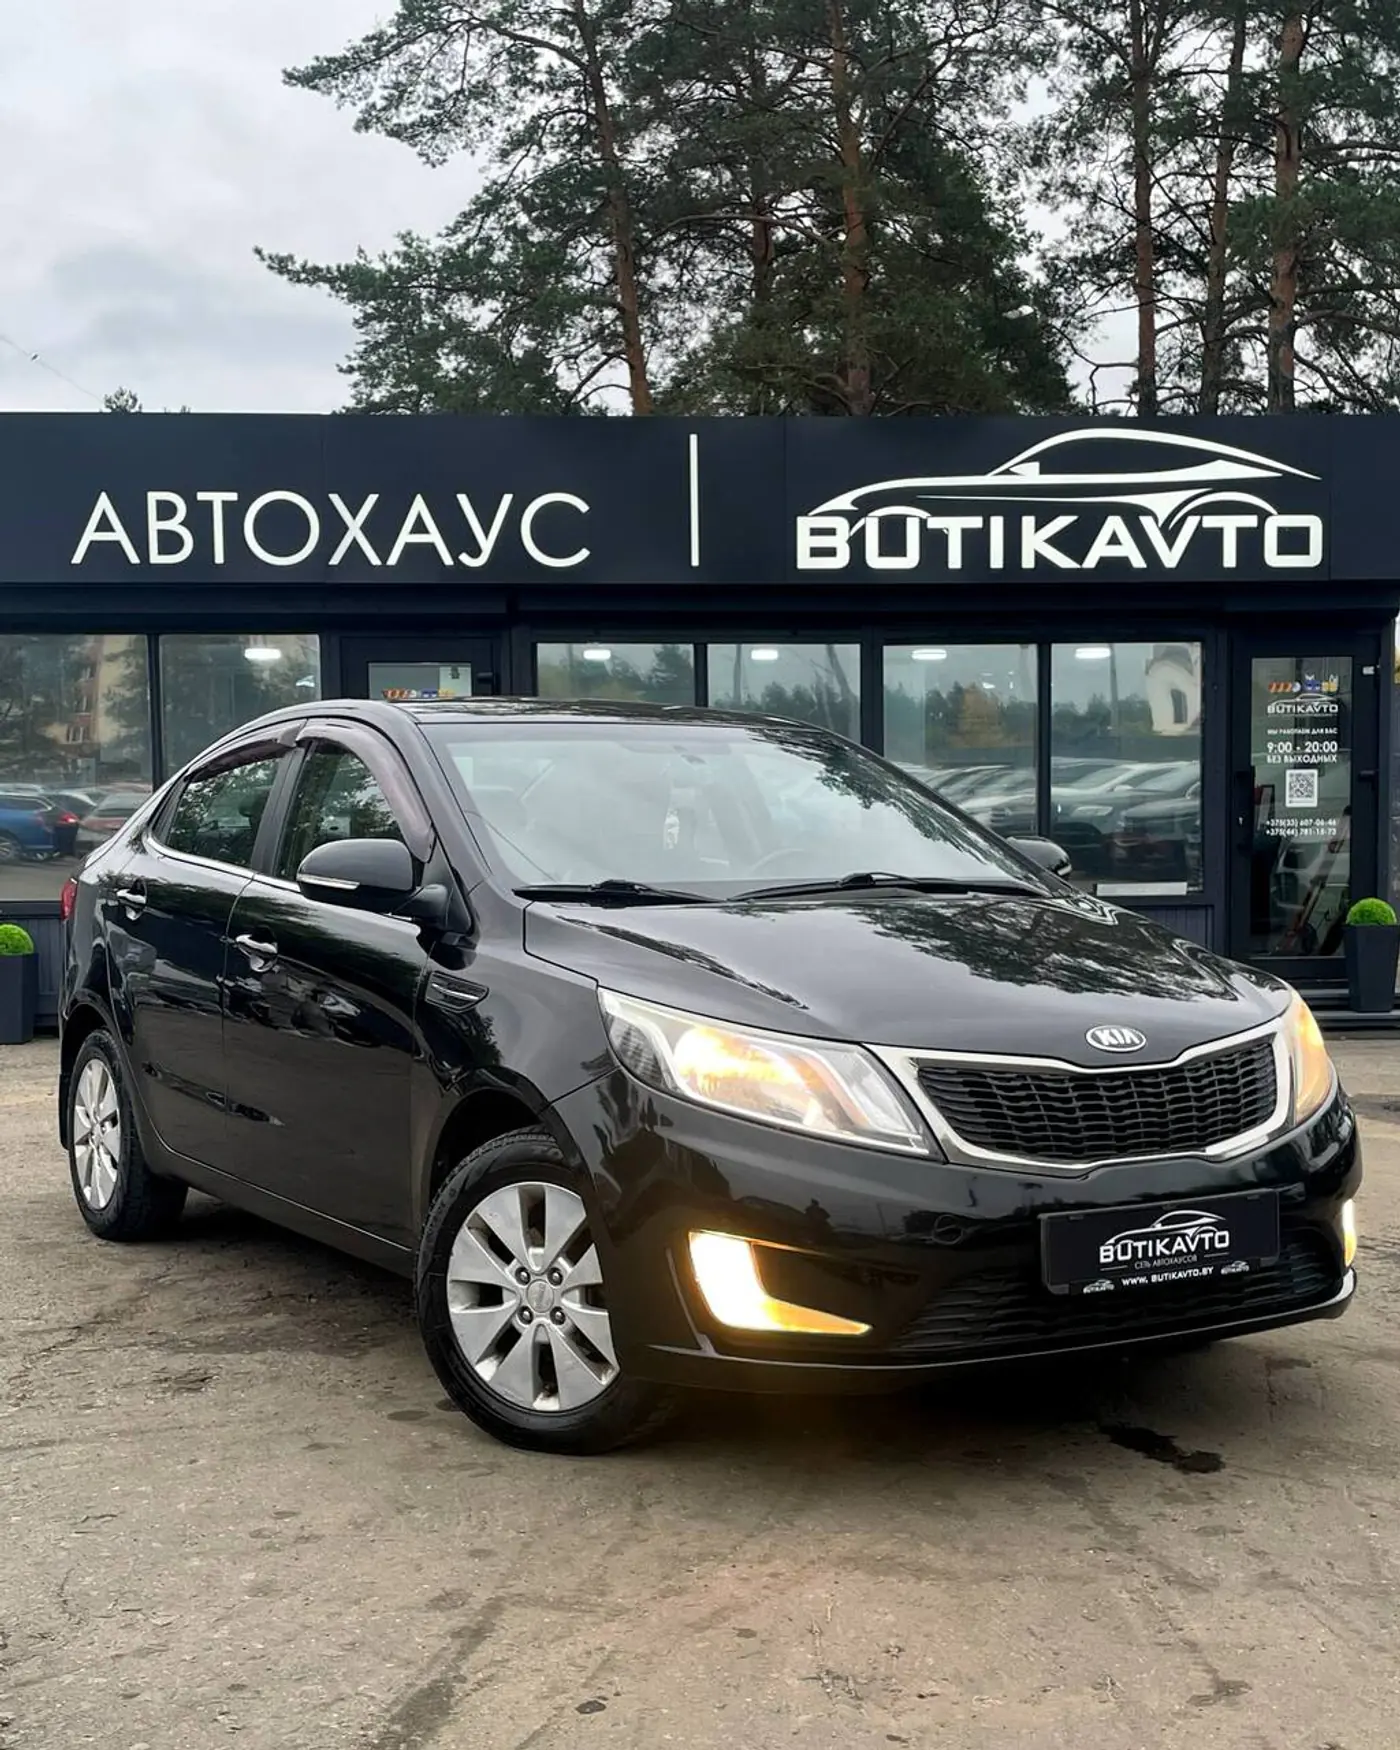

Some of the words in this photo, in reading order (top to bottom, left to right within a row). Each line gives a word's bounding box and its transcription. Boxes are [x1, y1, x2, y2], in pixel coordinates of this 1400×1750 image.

[71, 489, 591, 568] АВТОХАУС
[796, 513, 1324, 570] BUTIKAVTO
[1267, 704, 1338, 714] BUTIKAVTO
[1267, 741, 1292, 753] 9:00
[1304, 740, 1338, 753] 20:00
[1267, 755, 1281, 764] БЕЗ
[1283, 754, 1337, 764] ВЫХОДНЫХ
[1094, 1027, 1140, 1046] KIA
[1099, 1230, 1230, 1264] BUTIKAVTO
[1150, 1265, 1214, 1283] BUTIKAVTO.BY
